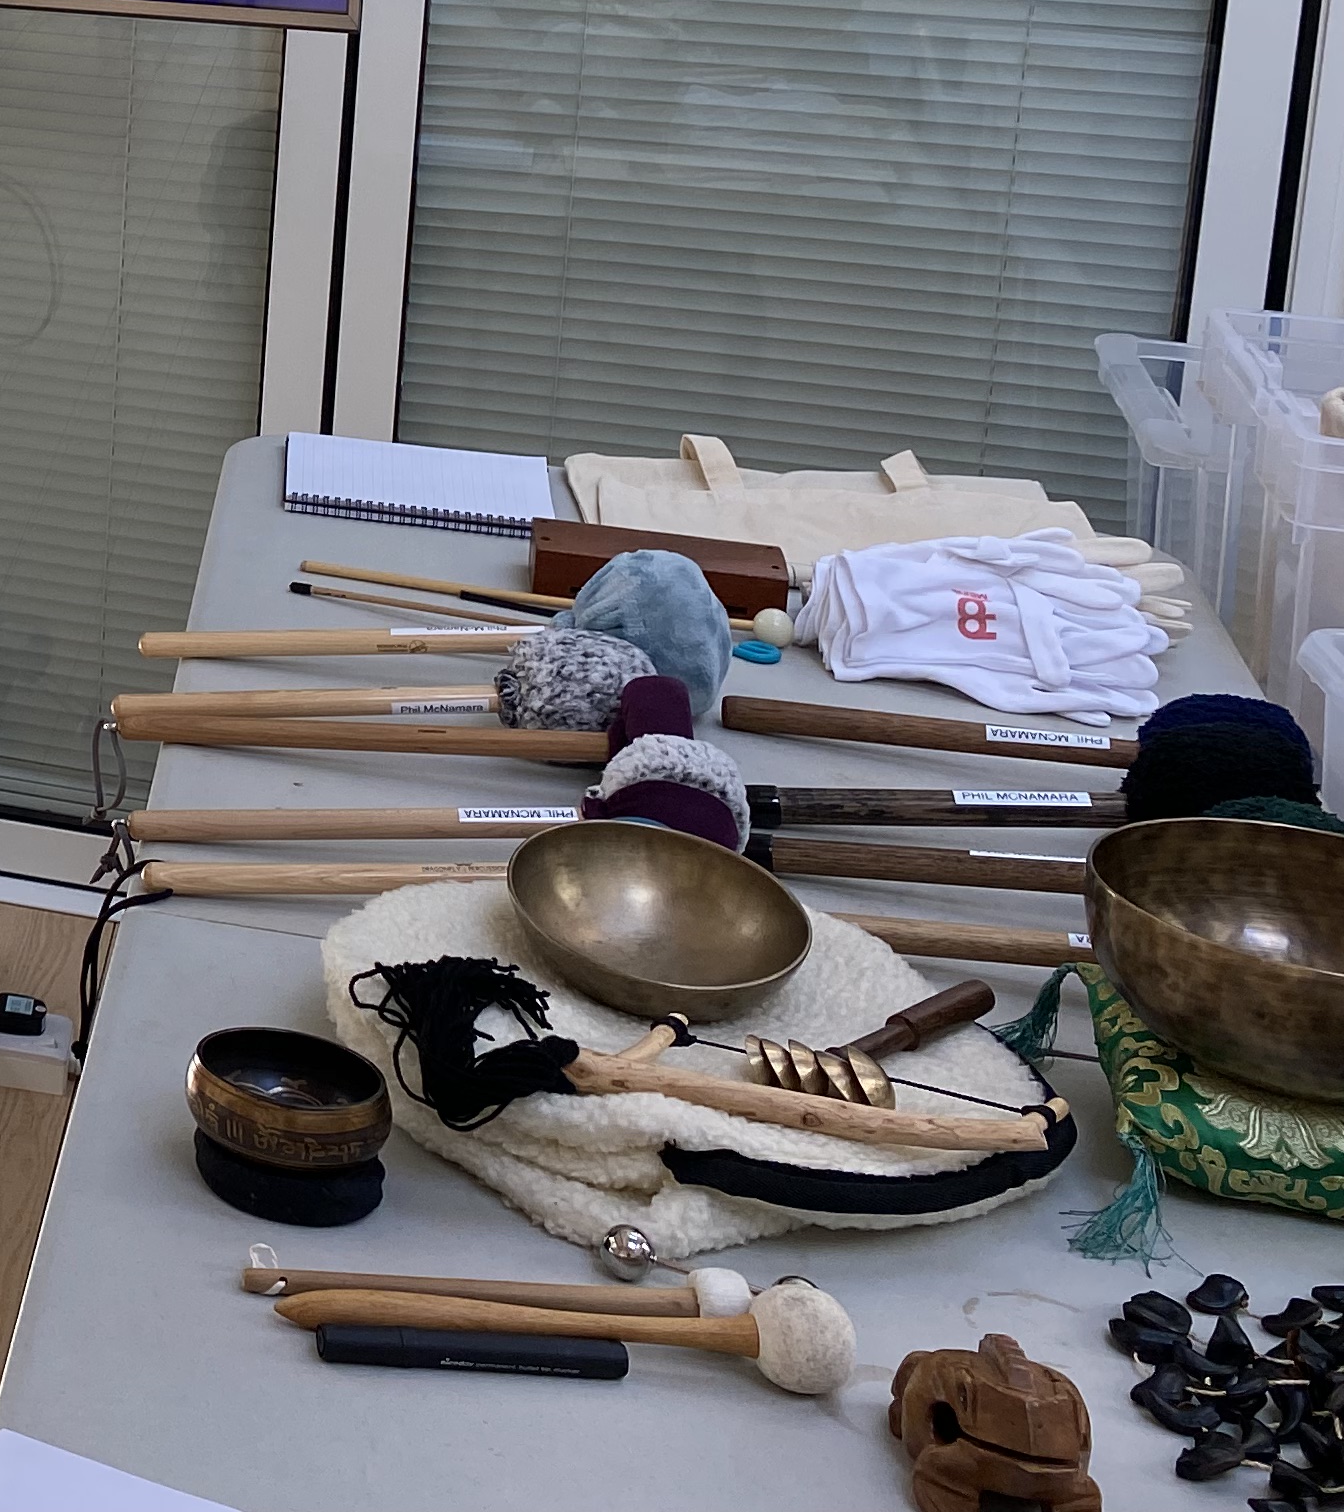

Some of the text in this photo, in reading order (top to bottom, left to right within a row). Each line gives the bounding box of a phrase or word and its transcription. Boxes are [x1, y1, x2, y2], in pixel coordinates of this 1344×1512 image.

[400, 703, 484, 715] Phil McNamara
[990, 728, 1103, 746] PHIL MCNAMARA
[961, 791, 993, 801] PHIL
[463, 808, 574, 819] PHIL MCNAMARA
